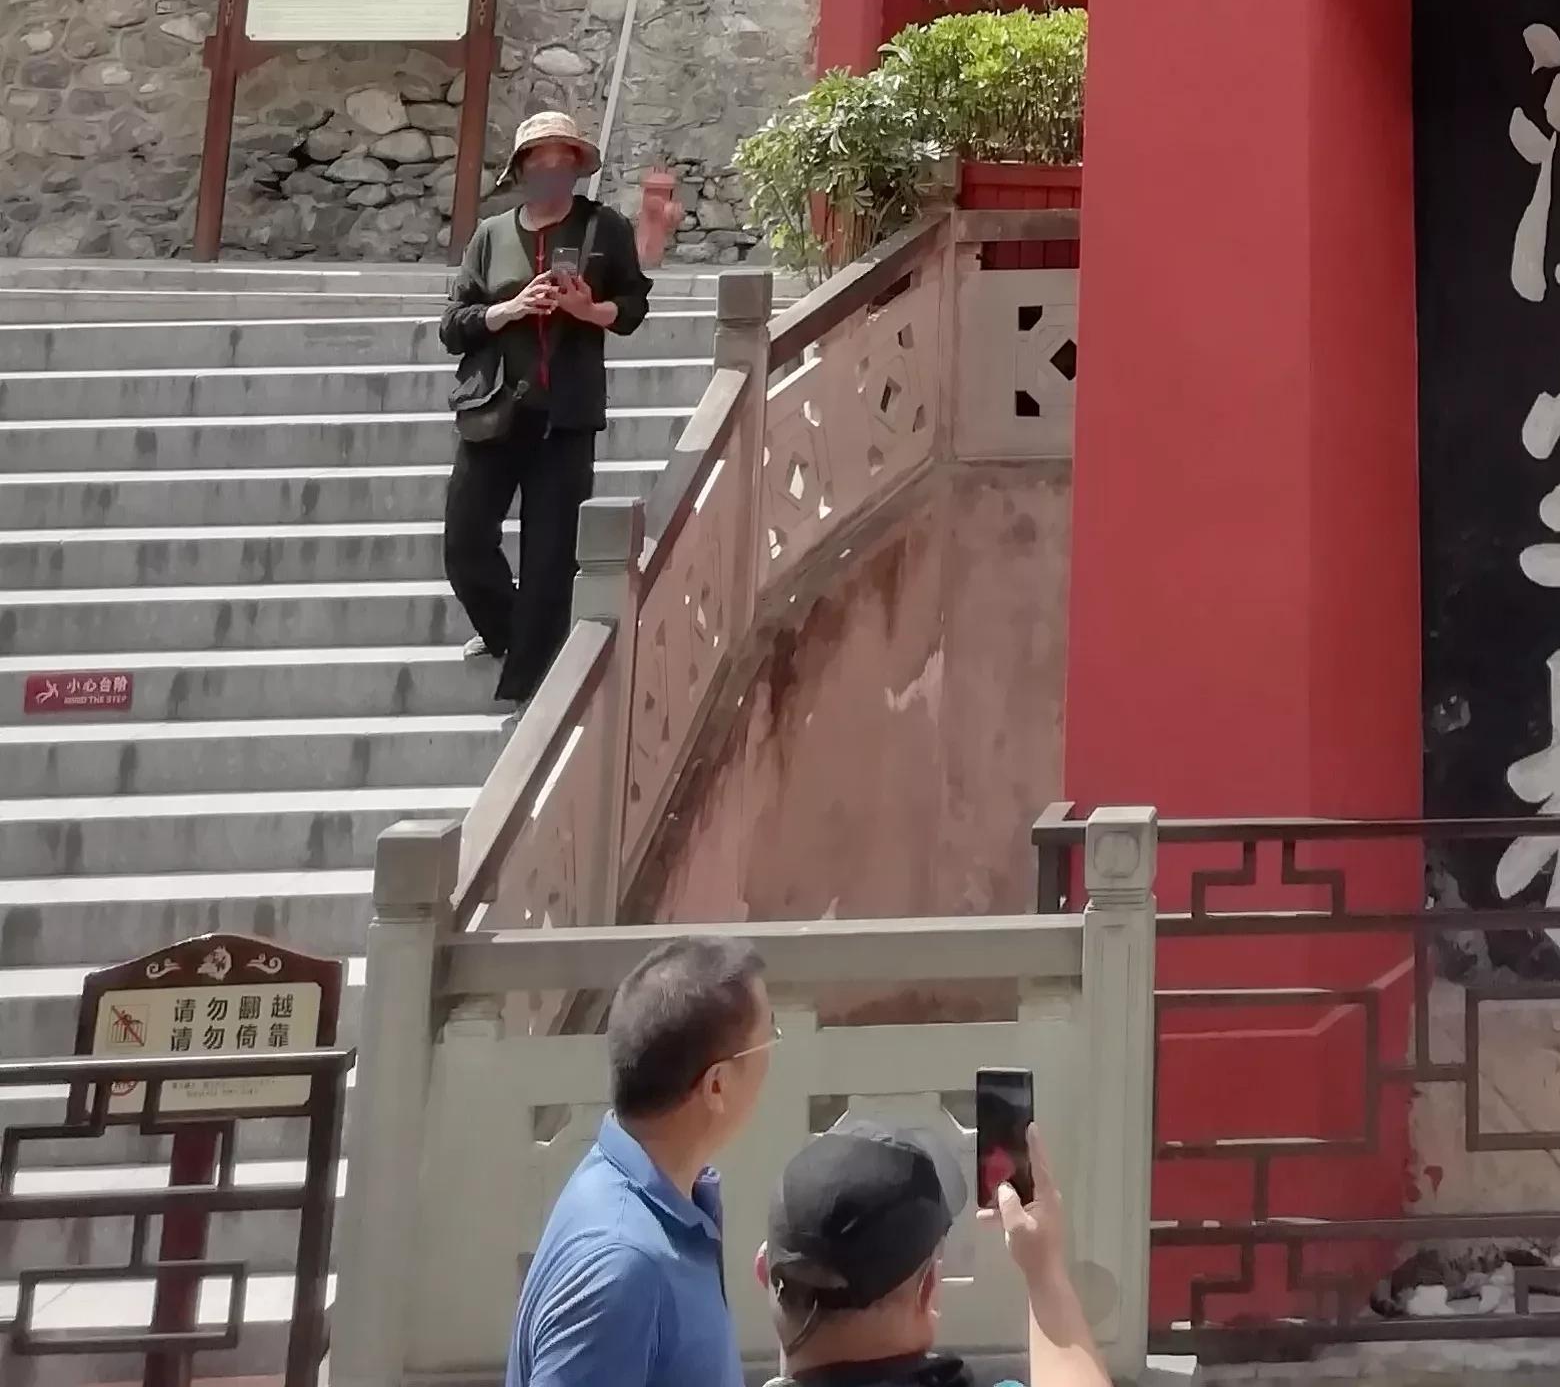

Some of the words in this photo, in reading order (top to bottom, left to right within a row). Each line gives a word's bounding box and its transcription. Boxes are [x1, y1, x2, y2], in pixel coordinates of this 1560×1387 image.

[66, 675, 128, 694] 小心台阶
[173, 993, 295, 1024] 请勿翻越
[169, 1023, 290, 1052] 请勿倚靠
